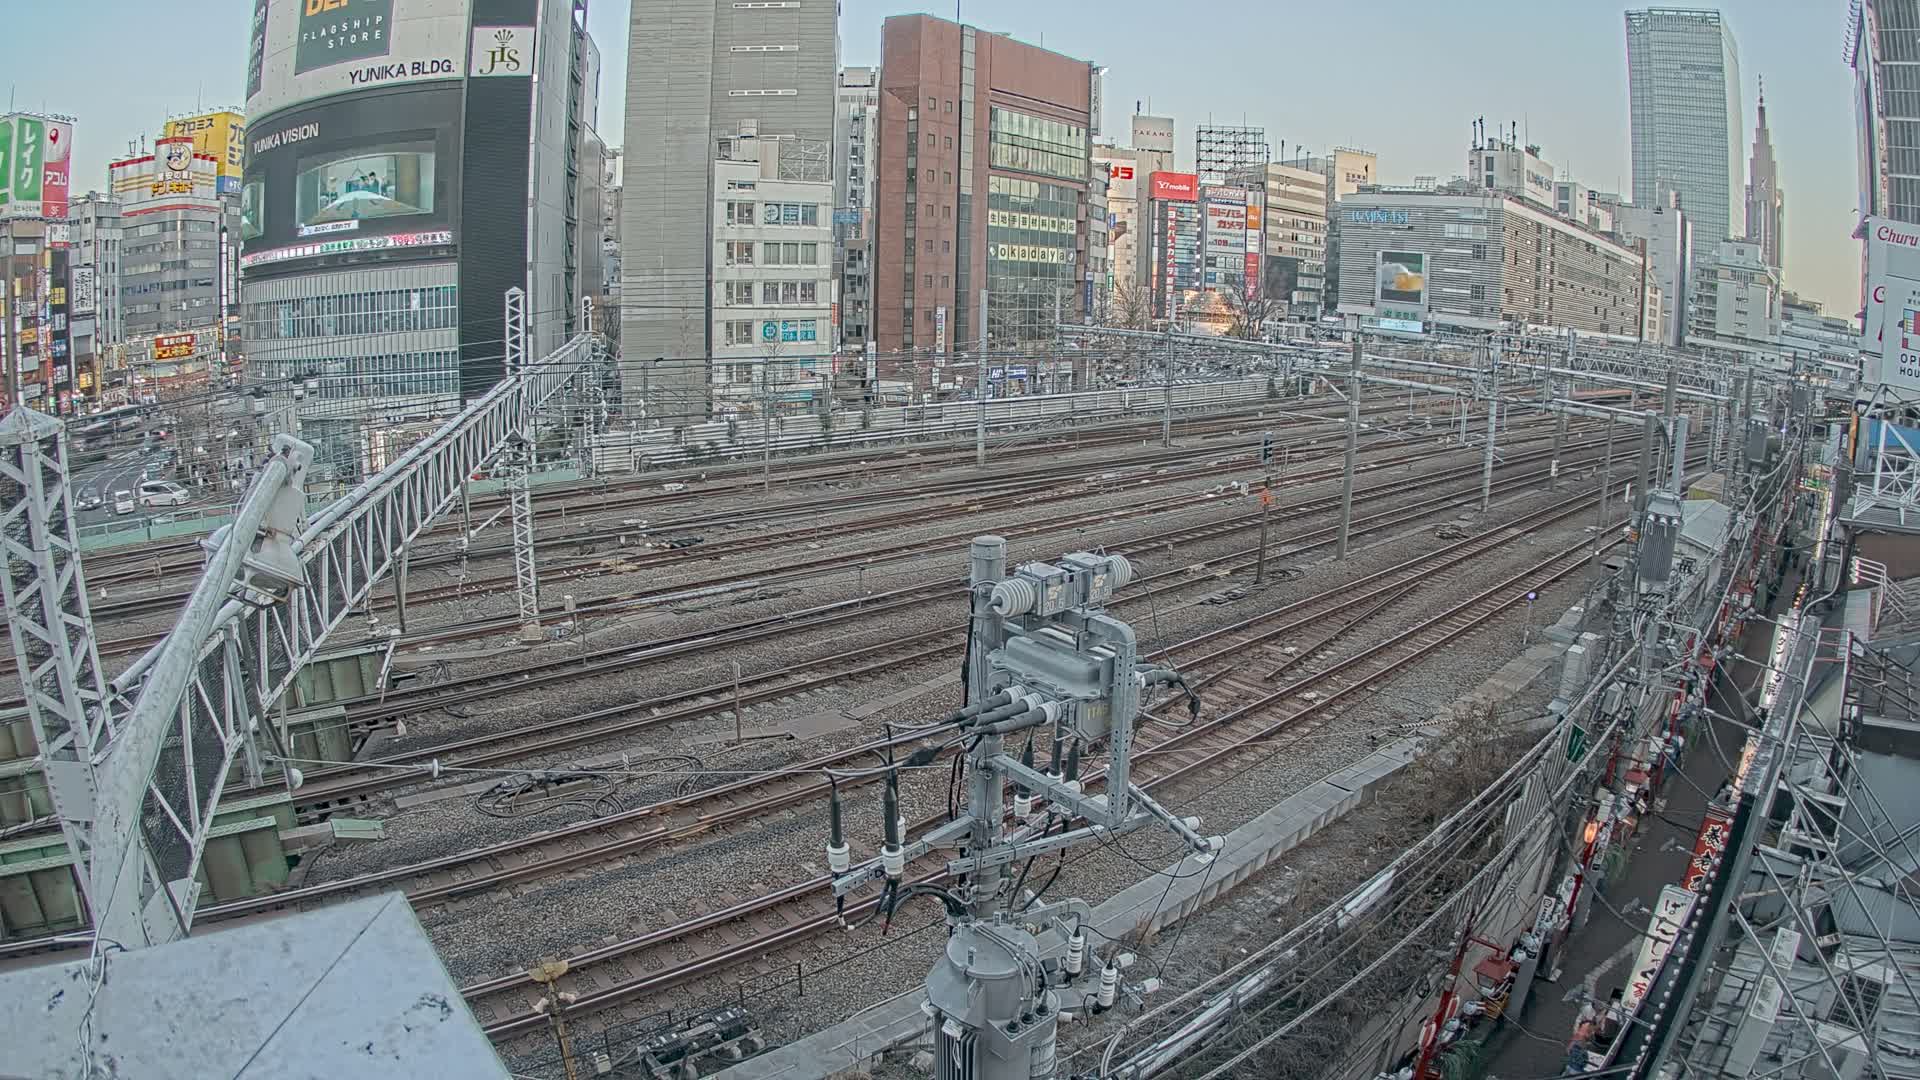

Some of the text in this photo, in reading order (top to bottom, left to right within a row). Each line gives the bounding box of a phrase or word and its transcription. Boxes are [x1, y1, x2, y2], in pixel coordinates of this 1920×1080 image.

[303, 15, 383, 43] FLAGSHIP
[328, 30, 382, 49] STORE
[349, 59, 456, 85] YUNIKA BLDG.
[254, 122, 319, 155] YUNIKA VISION
[1134, 129, 1173, 138] TAKANO
[21, 122, 36, 192] レイク
[45, 171, 68, 186] アコム
[1000, 246, 1065, 260] okadaya
[1900, 353, 1920, 367] OP
